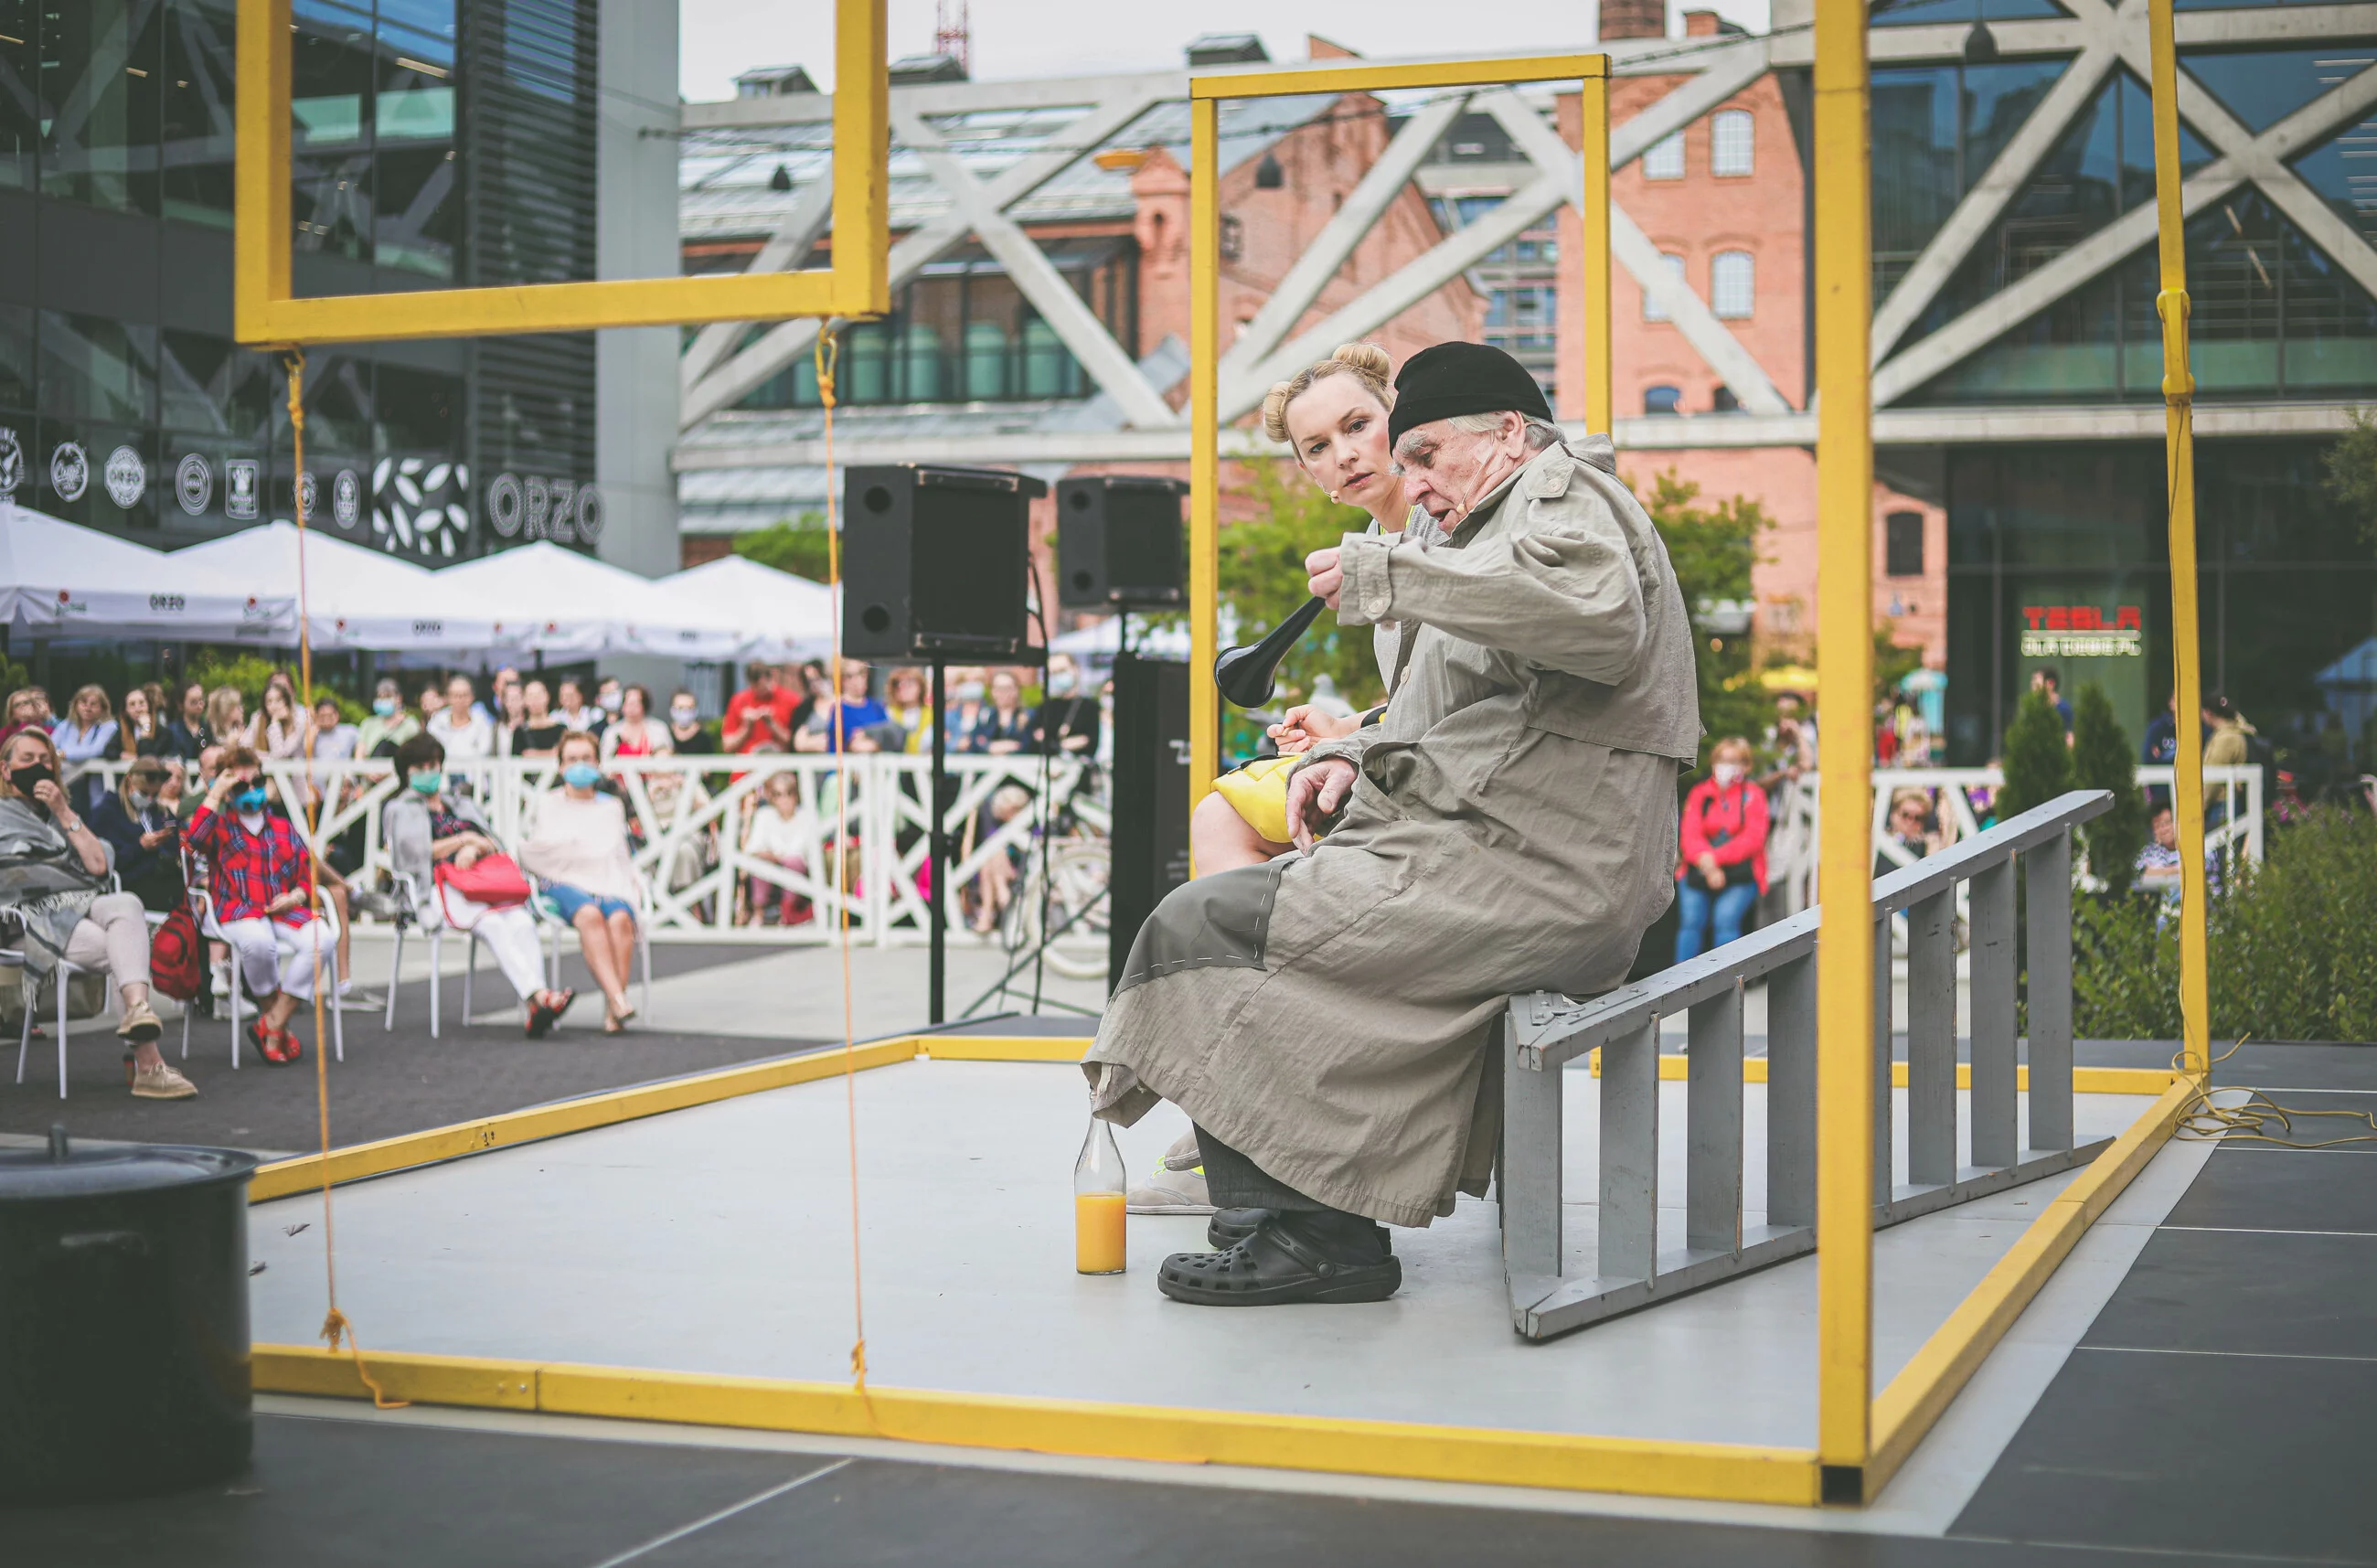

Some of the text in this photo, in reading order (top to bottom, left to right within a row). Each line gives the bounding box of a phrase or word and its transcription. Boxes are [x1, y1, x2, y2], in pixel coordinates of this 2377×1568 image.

[489, 473, 605, 545] ORZO
[149, 593, 187, 611] ORZO
[2021, 605, 2142, 630] TESLA
